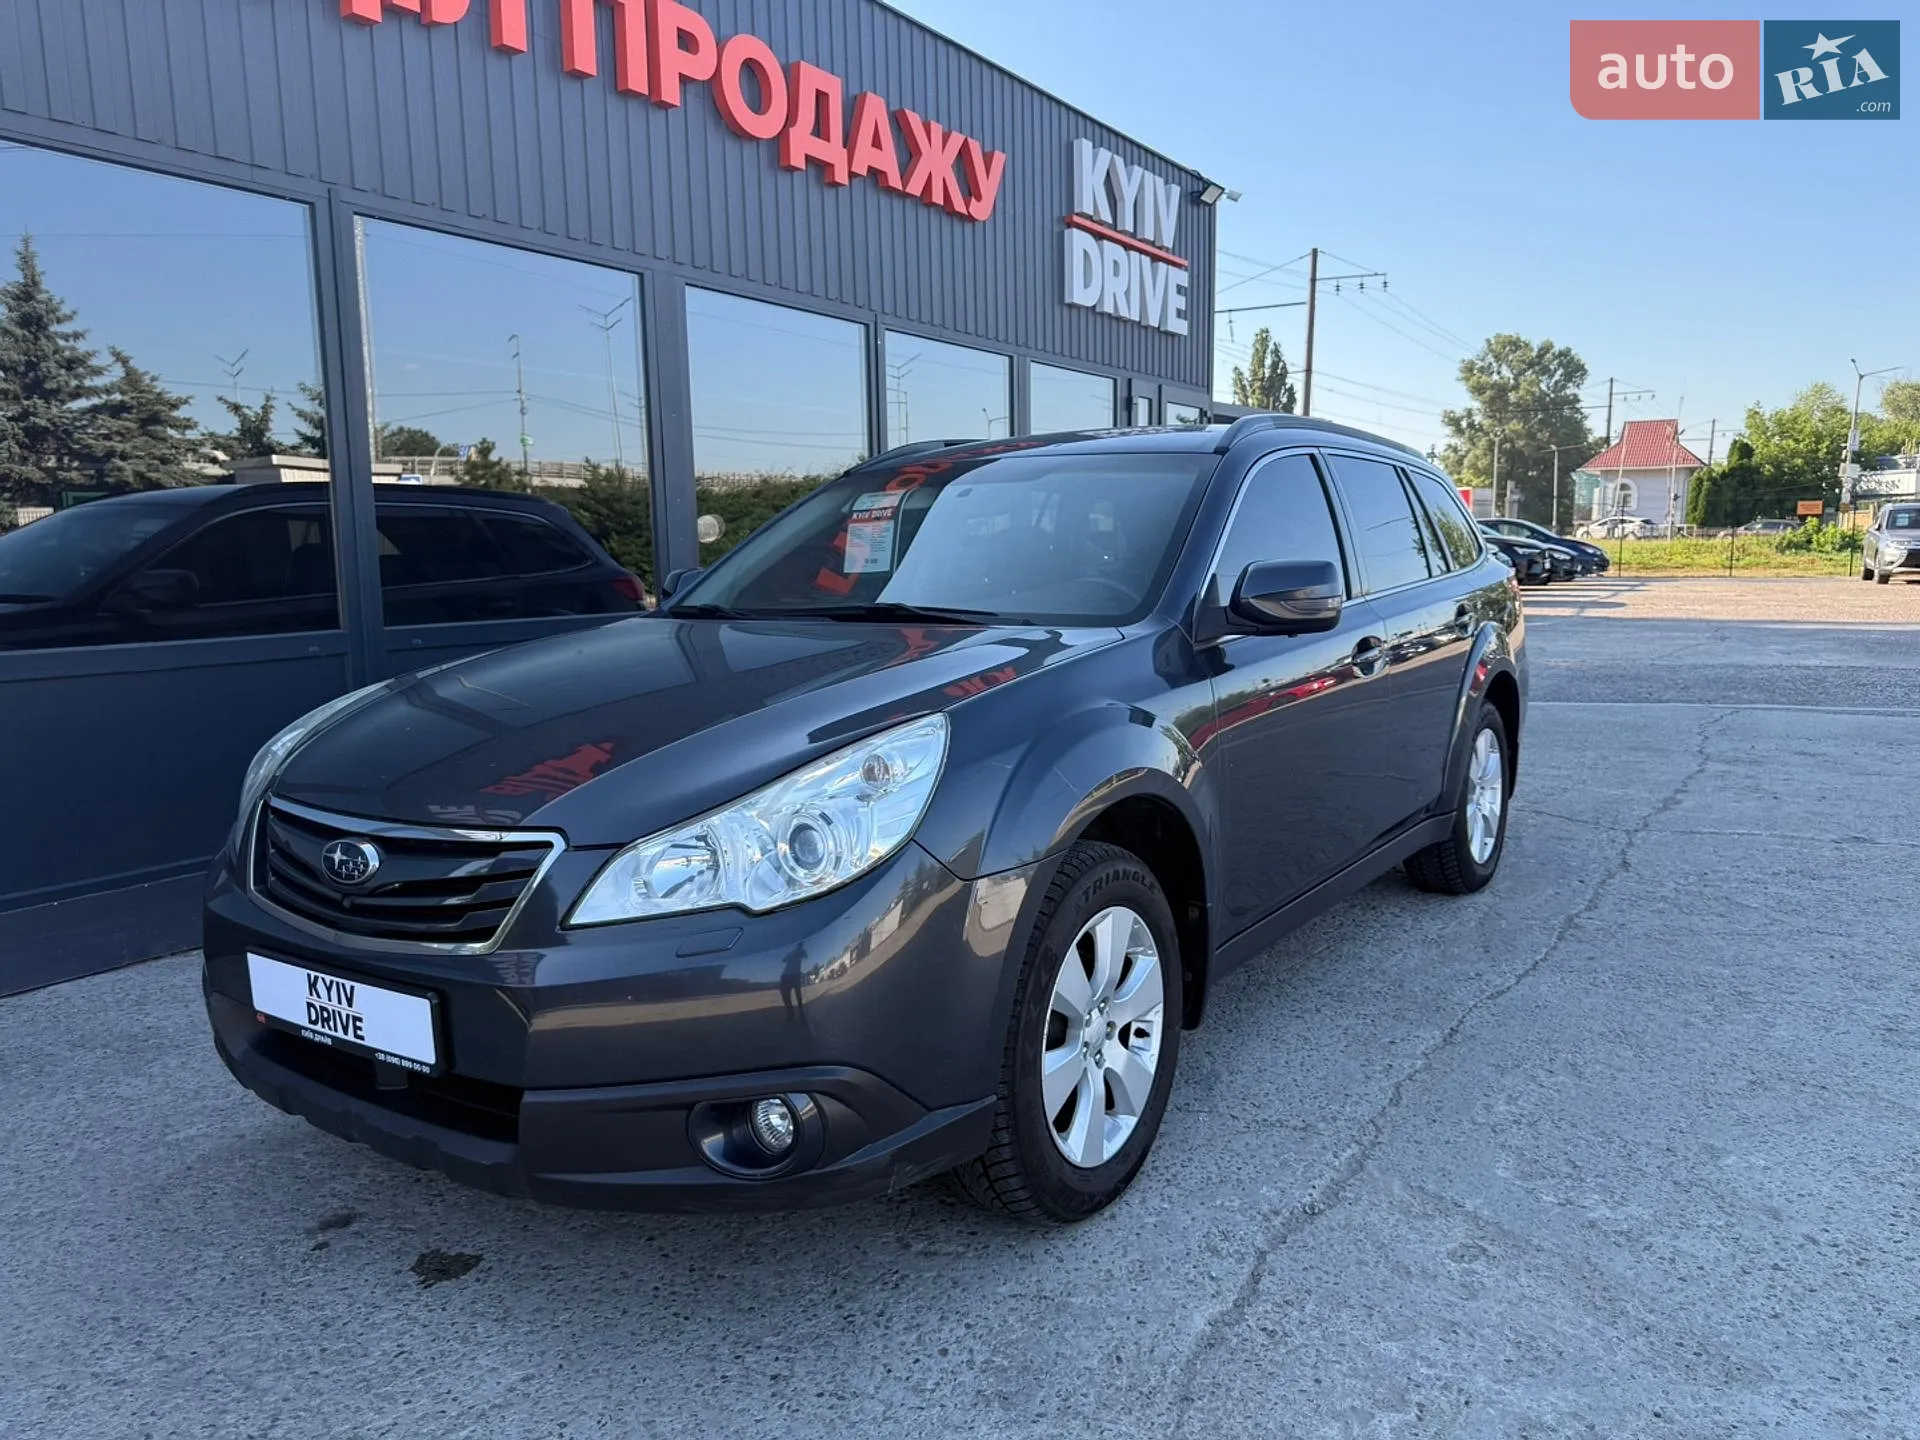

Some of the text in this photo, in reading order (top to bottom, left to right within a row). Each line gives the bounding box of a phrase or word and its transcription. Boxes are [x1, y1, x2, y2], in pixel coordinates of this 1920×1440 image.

[1073, 137, 1181, 251] KYIV
[1064, 227, 1188, 336] DRIVE
[1081, 868, 1158, 903] TRIANGLE
[306, 972, 355, 1009] KYIV
[306, 1001, 366, 1041] DRIVE
